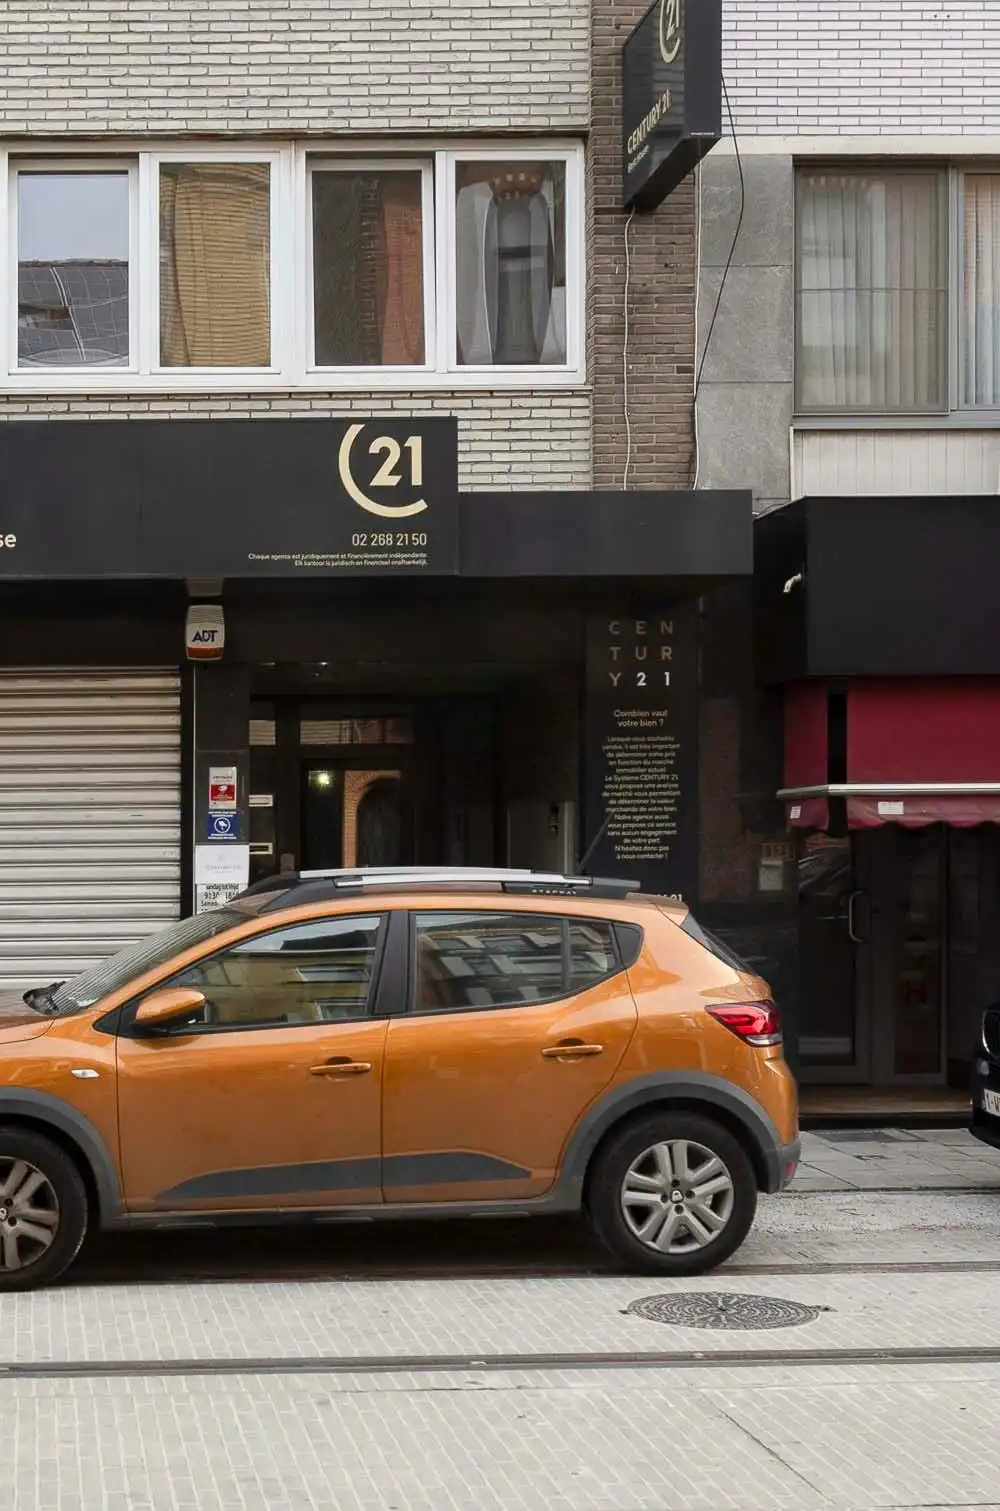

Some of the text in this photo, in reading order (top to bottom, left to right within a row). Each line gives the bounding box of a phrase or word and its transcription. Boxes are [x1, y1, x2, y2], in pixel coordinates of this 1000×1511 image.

[627, 98, 661, 155] CENTURY
[352, 533, 368, 546] 02
[370, 533, 393, 546] 268
[192, 630, 218, 643] ADT
[613, 709, 649, 718] Combien
[618, 719, 639, 727] votre
[640, 718, 657, 727] bien
